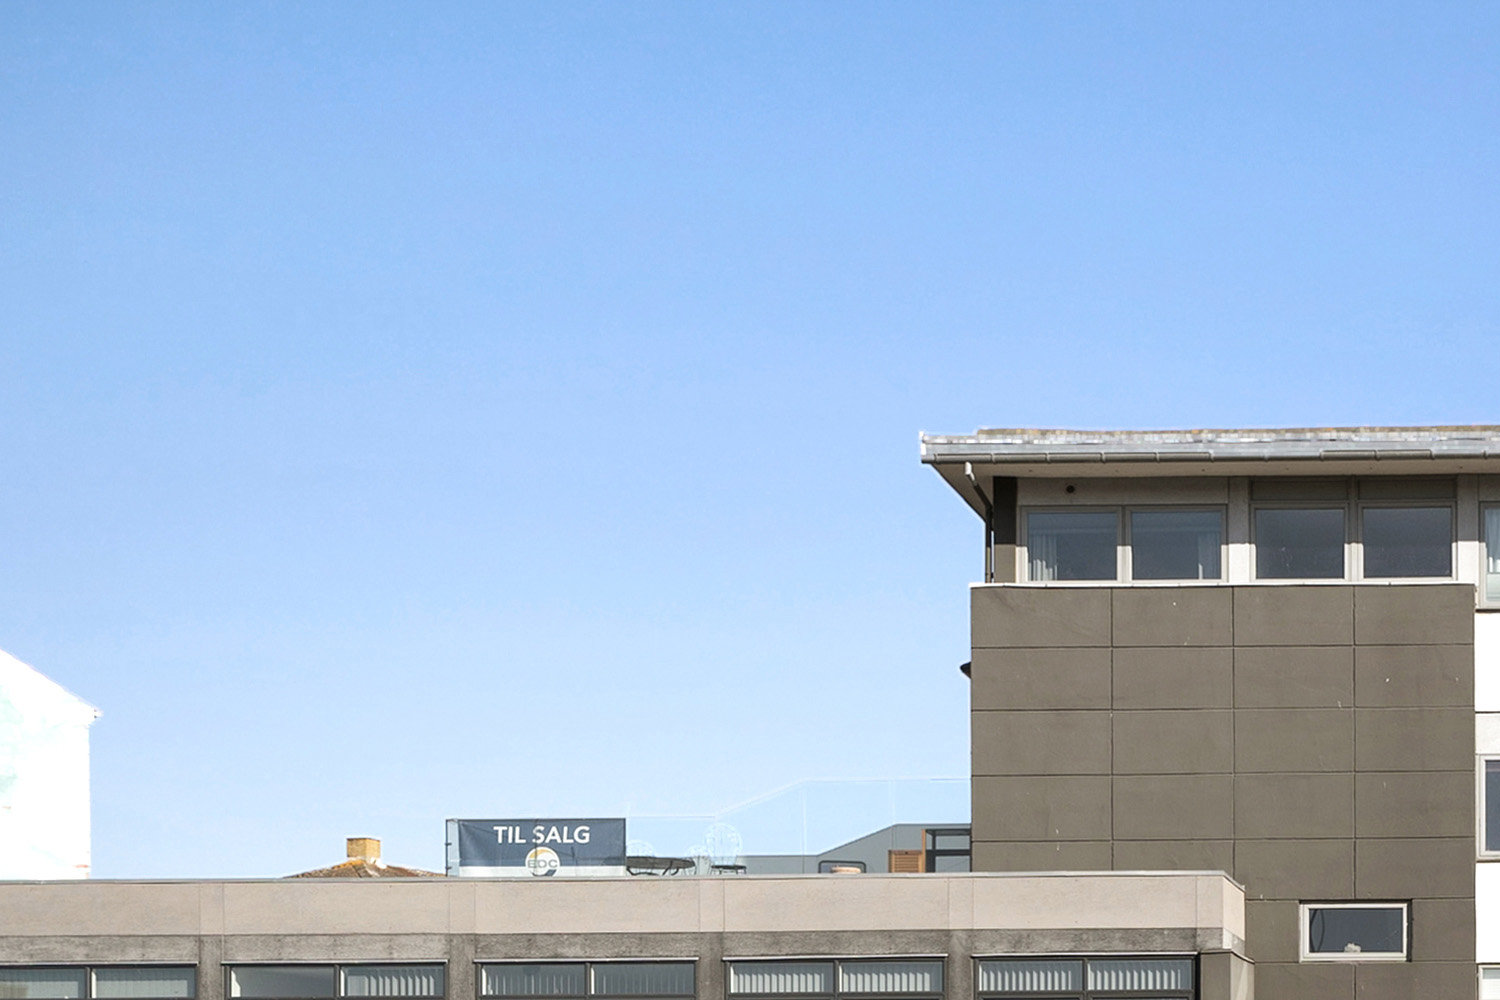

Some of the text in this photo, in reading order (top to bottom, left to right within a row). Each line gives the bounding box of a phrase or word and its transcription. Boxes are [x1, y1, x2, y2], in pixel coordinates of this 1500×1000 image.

[493, 825, 591, 844] TIL SALG
[528, 859, 558, 868] EDC
